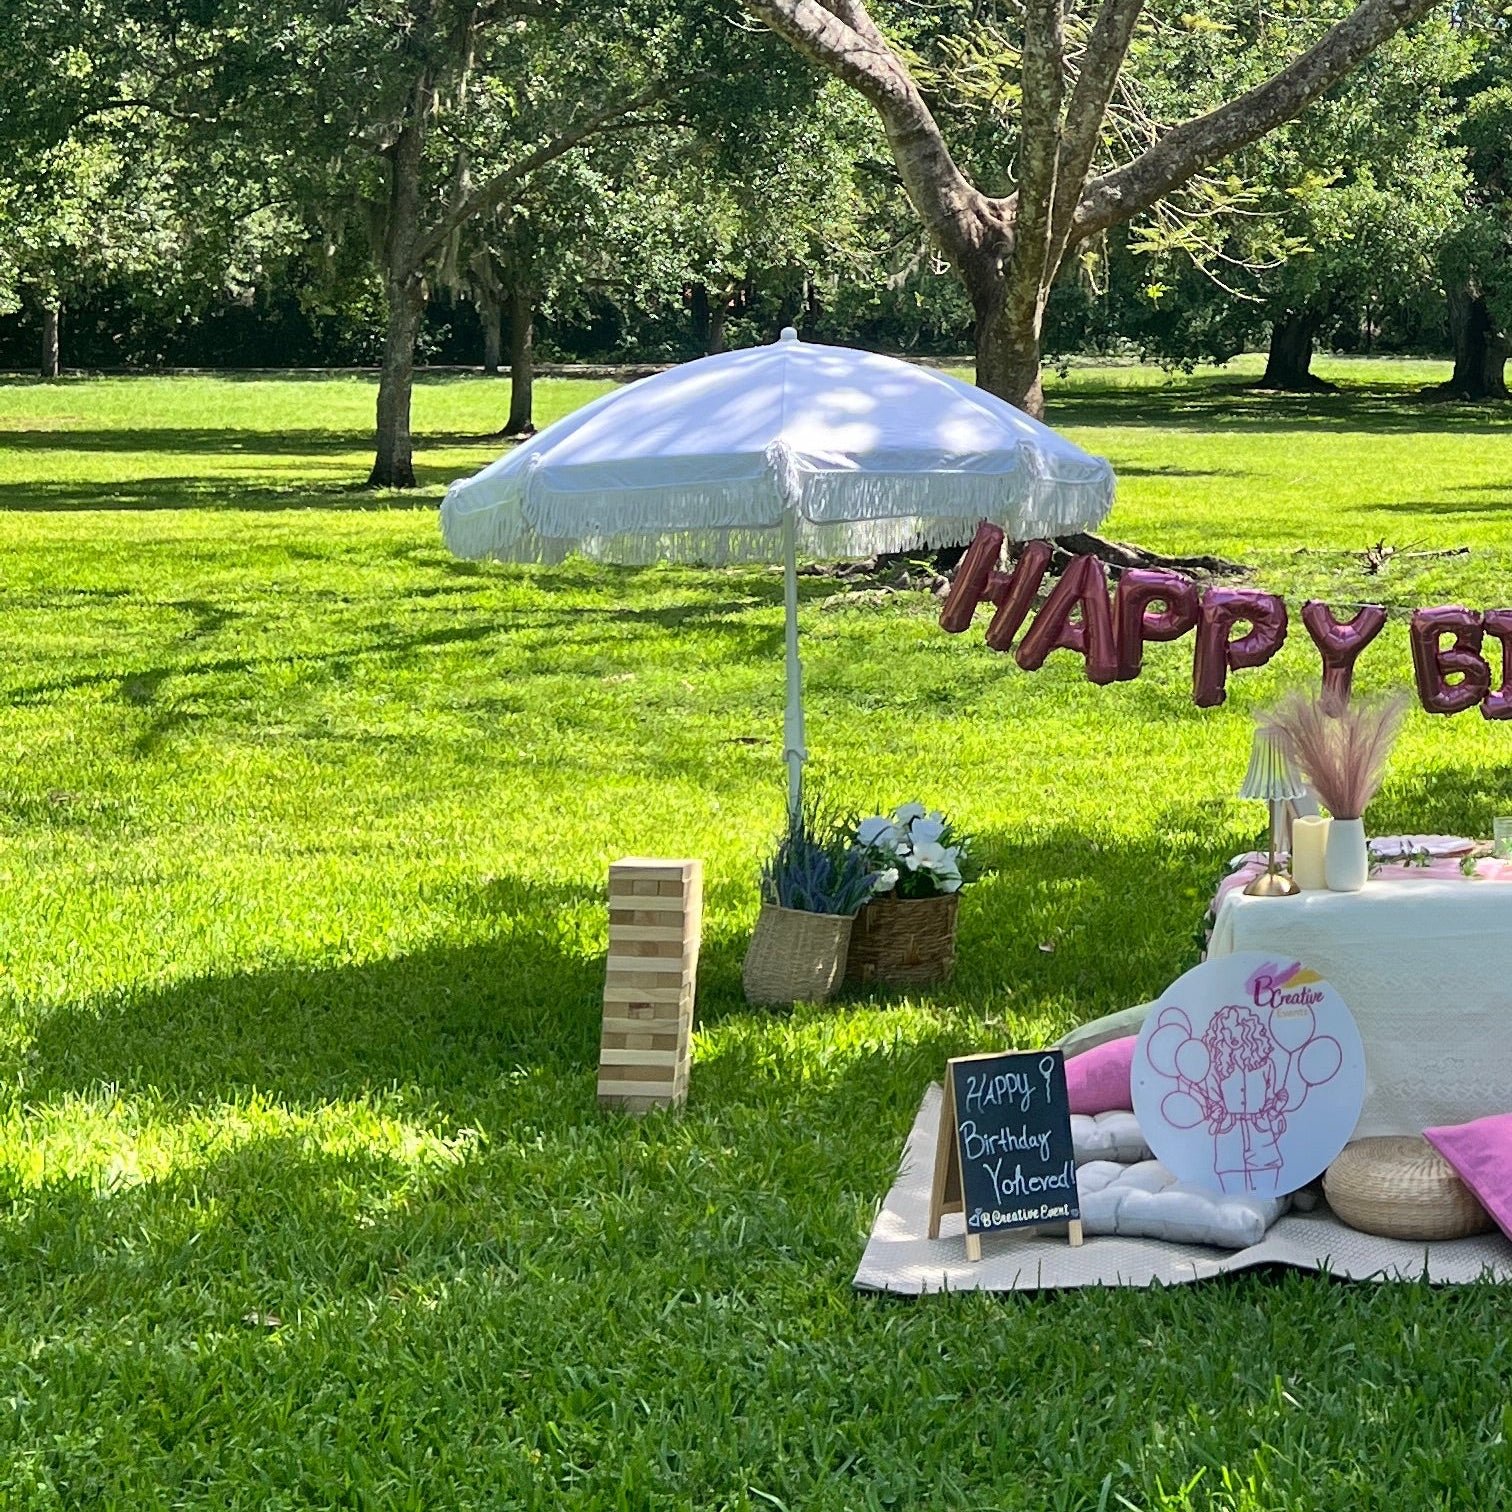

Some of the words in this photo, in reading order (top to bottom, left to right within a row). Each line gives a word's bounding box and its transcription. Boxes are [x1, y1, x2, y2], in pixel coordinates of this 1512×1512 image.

[939, 518, 1388, 718] HAPPY
[960, 1120, 1052, 1162] Birthday
[992, 1209, 1040, 1226] Creative
